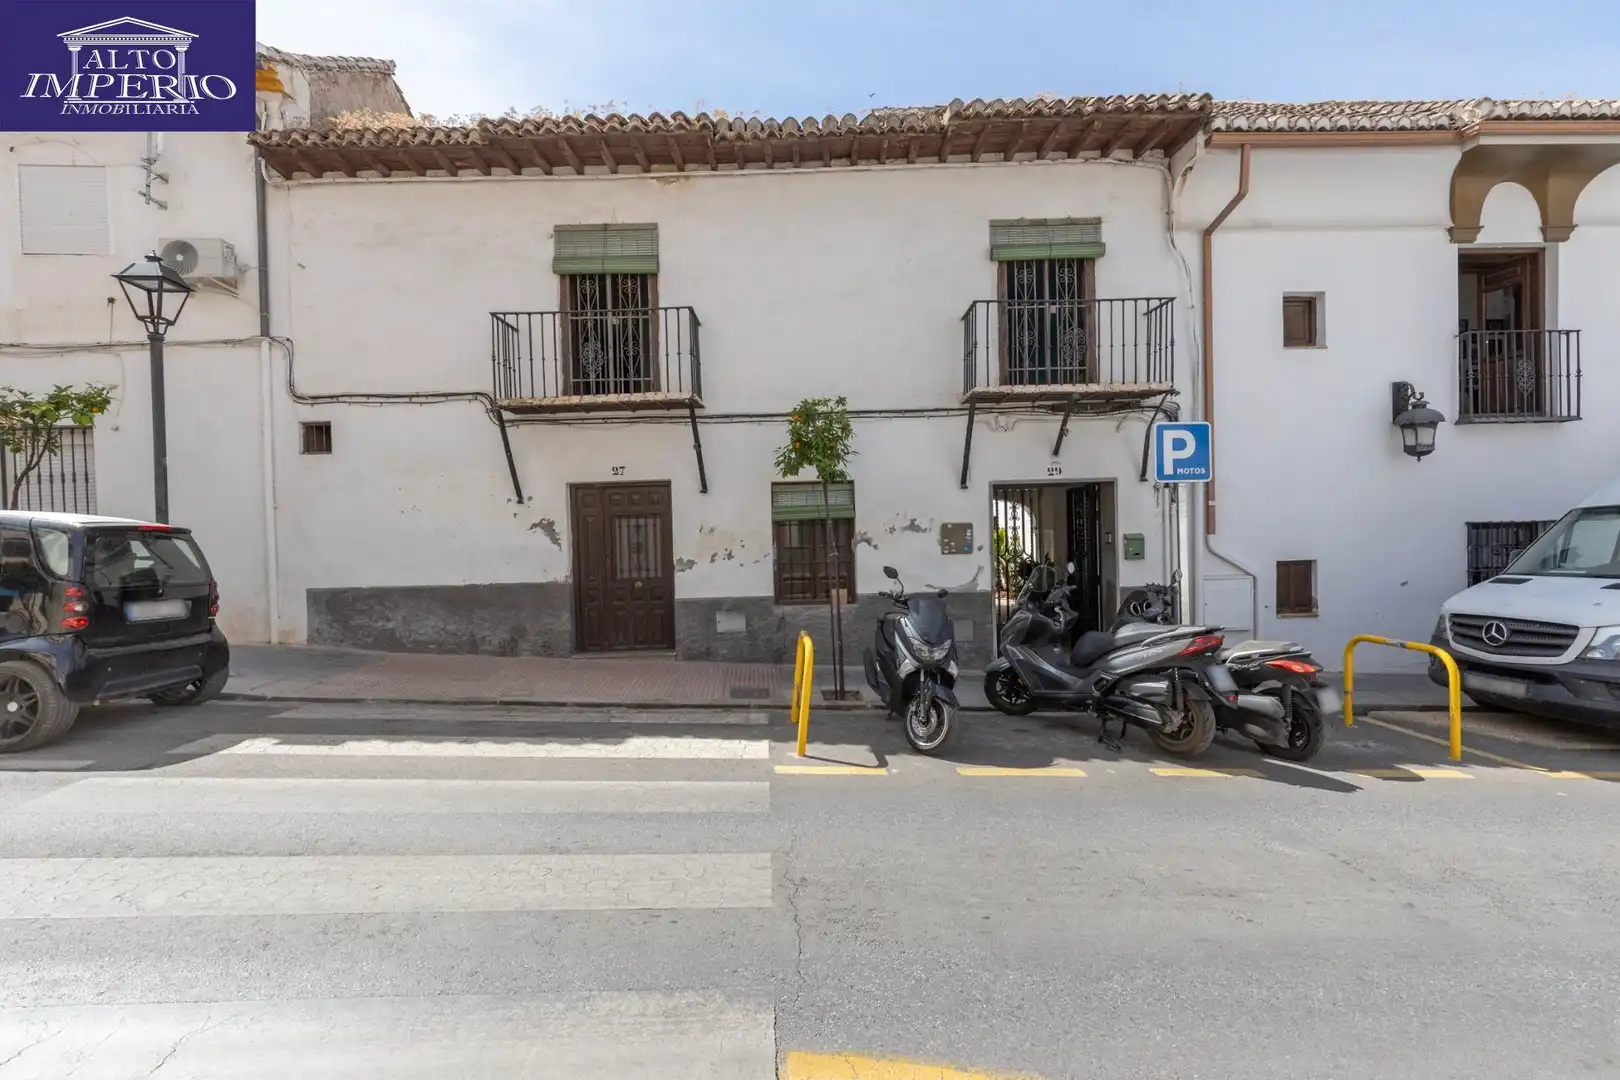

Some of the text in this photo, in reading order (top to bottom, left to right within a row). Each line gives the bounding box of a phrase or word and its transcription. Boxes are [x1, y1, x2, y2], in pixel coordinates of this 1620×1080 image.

[1163, 429, 1196, 475] P
[611, 465, 626, 476] 27
[1047, 466, 1062, 477] 29
[1177, 467, 1206, 475] MOTOS
